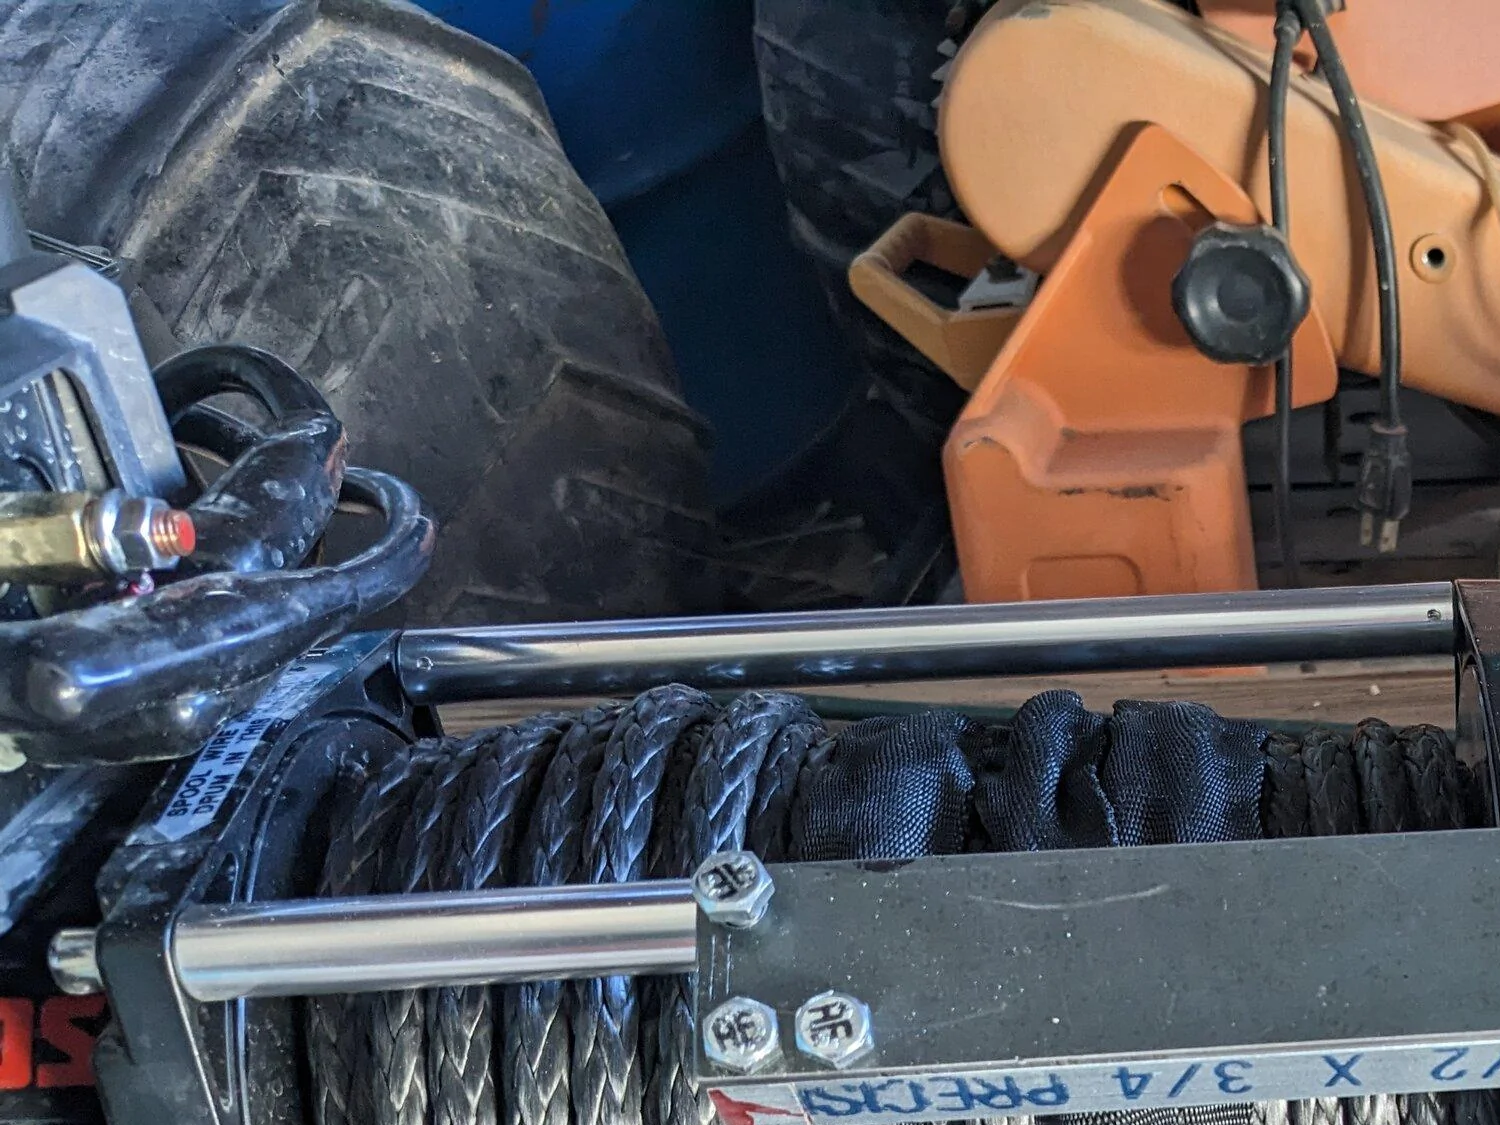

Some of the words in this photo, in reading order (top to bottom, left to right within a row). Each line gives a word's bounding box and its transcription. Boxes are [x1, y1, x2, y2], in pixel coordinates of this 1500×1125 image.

[167, 768, 213, 817] SPOOL
[201, 727, 239, 763] WIRE
[192, 773, 235, 815] DRUM
[222, 750, 248, 767] IN
[235, 717, 272, 746] THIS
[1111, 1059, 1255, 1101] 3/4
[1320, 1053, 1364, 1088] X
